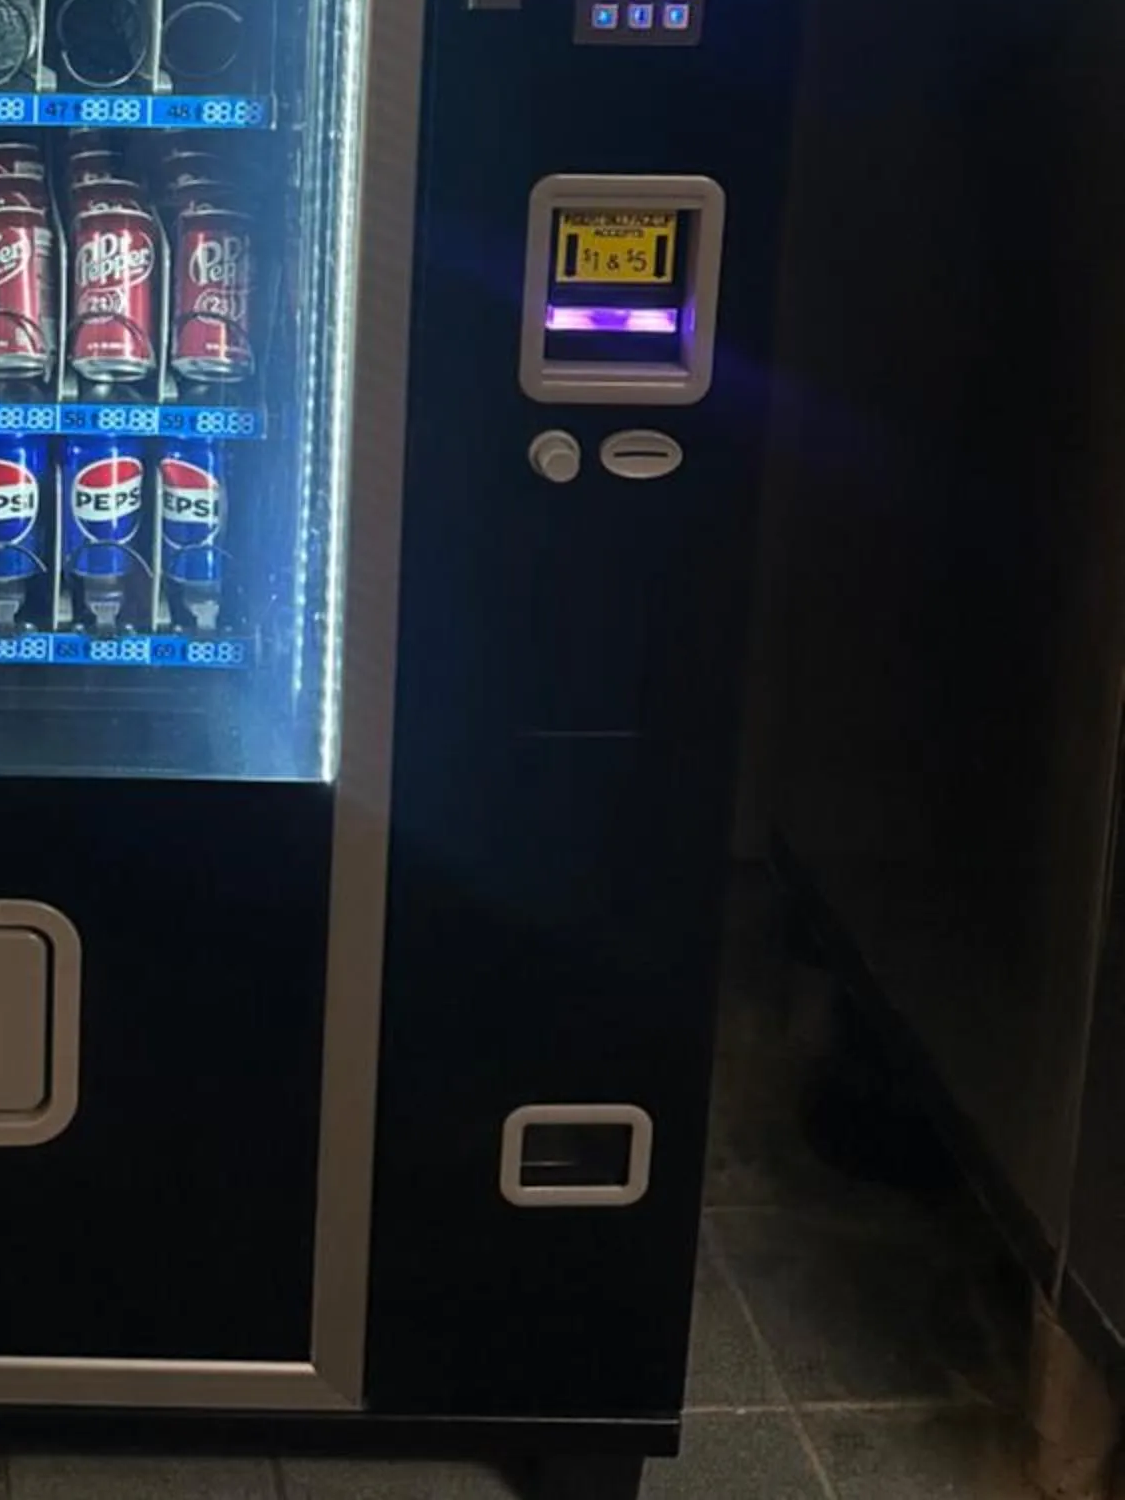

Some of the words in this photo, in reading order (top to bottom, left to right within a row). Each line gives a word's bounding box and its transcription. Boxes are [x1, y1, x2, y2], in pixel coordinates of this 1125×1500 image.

[583, 247, 599, 272] $1
[627, 247, 648, 272] $5
[76, 486, 142, 513] PEPS
[161, 490, 220, 517] EPSI
